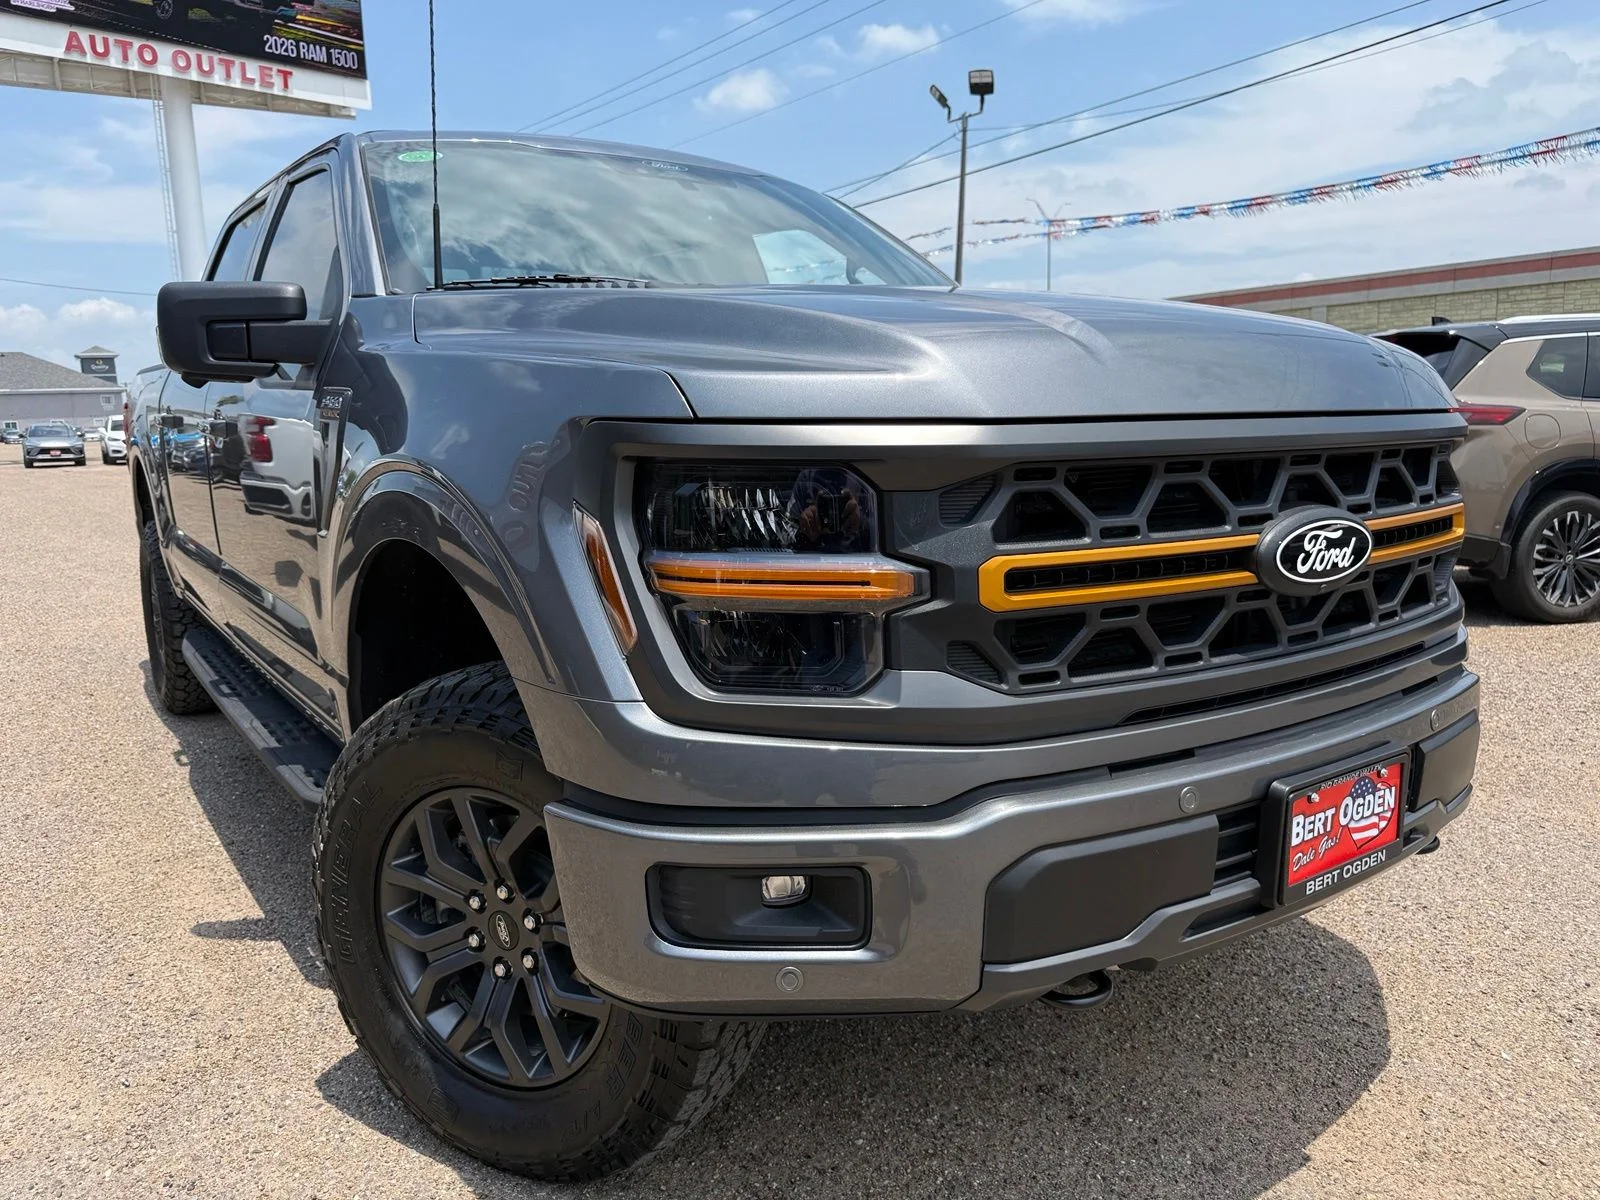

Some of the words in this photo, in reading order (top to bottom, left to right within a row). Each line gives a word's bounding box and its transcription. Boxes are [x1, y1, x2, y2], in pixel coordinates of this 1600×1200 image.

[64, 30, 160, 67] AUTO
[171, 48, 294, 92] OUTLET
[263, 34, 297, 58] 2026
[299, 41, 327, 64] RAM
[330, 48, 358, 70] 1500
[1296, 529, 1357, 574] Ford
[1291, 807, 1336, 848] BERT
[1339, 785, 1396, 827] OGDEN
[1292, 846, 1316, 872] Dale
[1306, 868, 1340, 896] BERT
[1342, 849, 1387, 880] OGDEN
